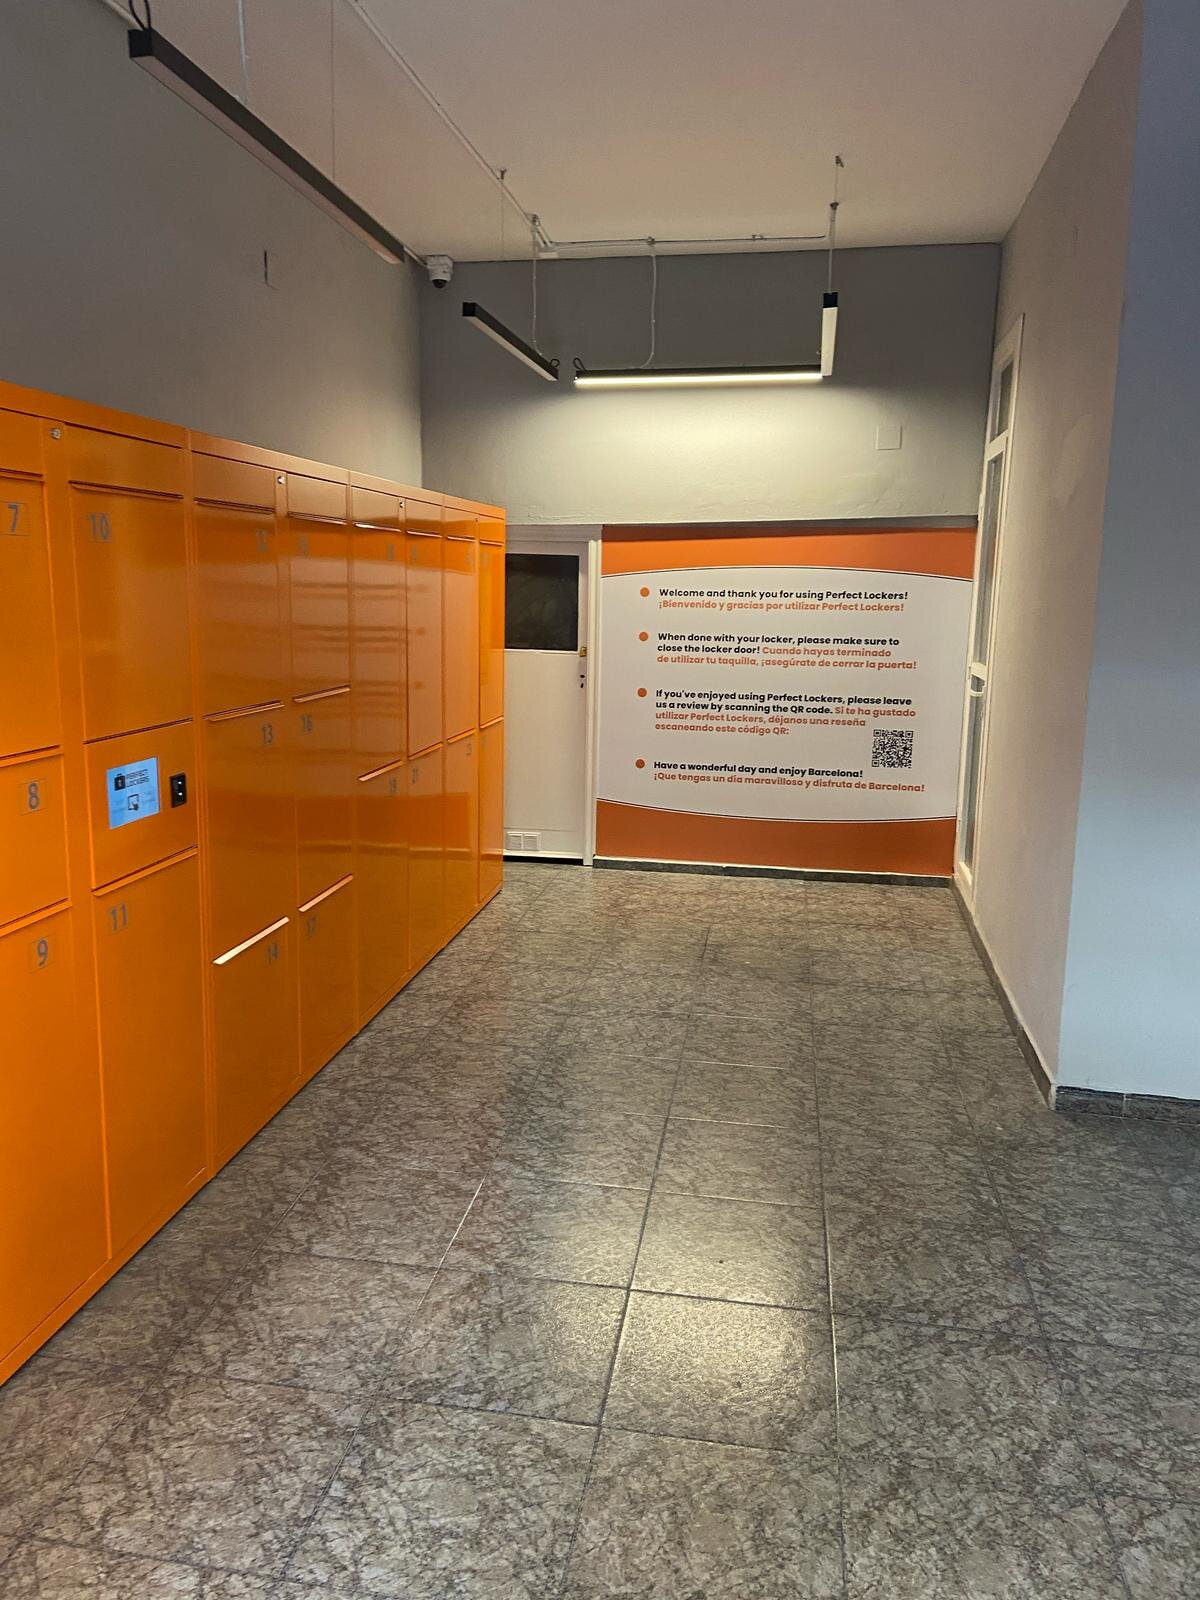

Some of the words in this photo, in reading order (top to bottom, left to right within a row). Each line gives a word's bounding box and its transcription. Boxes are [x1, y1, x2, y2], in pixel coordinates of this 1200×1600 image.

[7, 504, 19, 533] 7
[90, 513, 109, 540] 10
[659, 587, 705, 598] Welcome
[706, 588, 726, 598] and
[727, 588, 757, 598] thank
[759, 590, 778, 601] you
[779, 589, 794, 599] for
[795, 589, 824, 601] using
[826, 589, 863, 600] Perfect
[864, 590, 909, 600] Lockers!
[718, 602, 726, 612] y
[726, 600, 764, 612] gracias
[765, 602, 784, 613] por
[784, 601, 821, 611] utilizar
[822, 601, 859, 611] Perfect
[860, 602, 905, 612] Lockers!
[658, 632, 686, 642] When
[687, 632, 712, 643] done
[713, 633, 735, 643] with
[737, 635, 760, 646] your
[761, 634, 796, 646] locker,
[797, 635, 832, 647] please
[832, 635, 863, 646] make
[864, 638, 888, 646] sure
[888, 636, 900, 646] to
[657, 643, 683, 653] close
[684, 644, 701, 654] the
[702, 644, 733, 654] locker
[733, 644, 761, 655] door!
[762, 646, 802, 656] Cuando
[803, 646, 835, 659] hayas
[836, 647, 892, 657] terminado
[656, 654, 670, 664] de
[670, 654, 705, 665] utilizar
[705, 655, 717, 665] tu
[718, 655, 759, 668] taquilla,
[817, 658, 831, 668] de
[832, 660, 865, 668] cerrar
[865, 659, 877, 669] la
[877, 659, 918, 672] puerta!
[656, 689, 663, 699] If
[664, 689, 697, 702] you've
[697, 690, 737, 703] enjoyed
[738, 691, 766, 704] using
[767, 692, 803, 703] Perfect
[804, 693, 846, 706] Lockers,
[847, 694, 882, 707] please
[882, 695, 913, 706] leave
[655, 702, 668, 710] us
[668, 702, 676, 710] a
[676, 701, 710, 711] review
[710, 702, 724, 714] by
[724, 702, 771, 715] scanning
[772, 703, 789, 714] the
[790, 704, 805, 716] QR
[805, 704, 833, 715] code.
[835, 706, 844, 715] Si
[846, 706, 856, 716] te
[857, 706, 871, 716] ha
[872, 706, 916, 719] gustado
[655, 711, 689, 722] utilizar
[690, 712, 725, 723] Perfect
[726, 713, 767, 726] Lockers,
[809, 718, 830, 726] una
[655, 722, 714, 734] escaneando
[715, 724, 737, 734] este
[772, 726, 790, 738] QR:
[654, 760, 679, 771] Have
[679, 763, 686, 771] a
[687, 762, 737, 773] wonderful
[738, 764, 757, 776] day
[758, 764, 778, 775] and
[779, 765, 807, 778] enjoy
[808, 766, 863, 778] Barcelona!
[678, 773, 711, 786] tengas
[713, 776, 725, 784] un
[745, 775, 803, 787] maravilloso
[805, 780, 811, 790] y
[813, 778, 852, 789] disfruta
[854, 780, 867, 790] de
[869, 780, 924, 792] Barcelona!
[28, 783, 39, 810] 8
[110, 903, 128, 932] 11
[37, 939, 48, 967] 9
